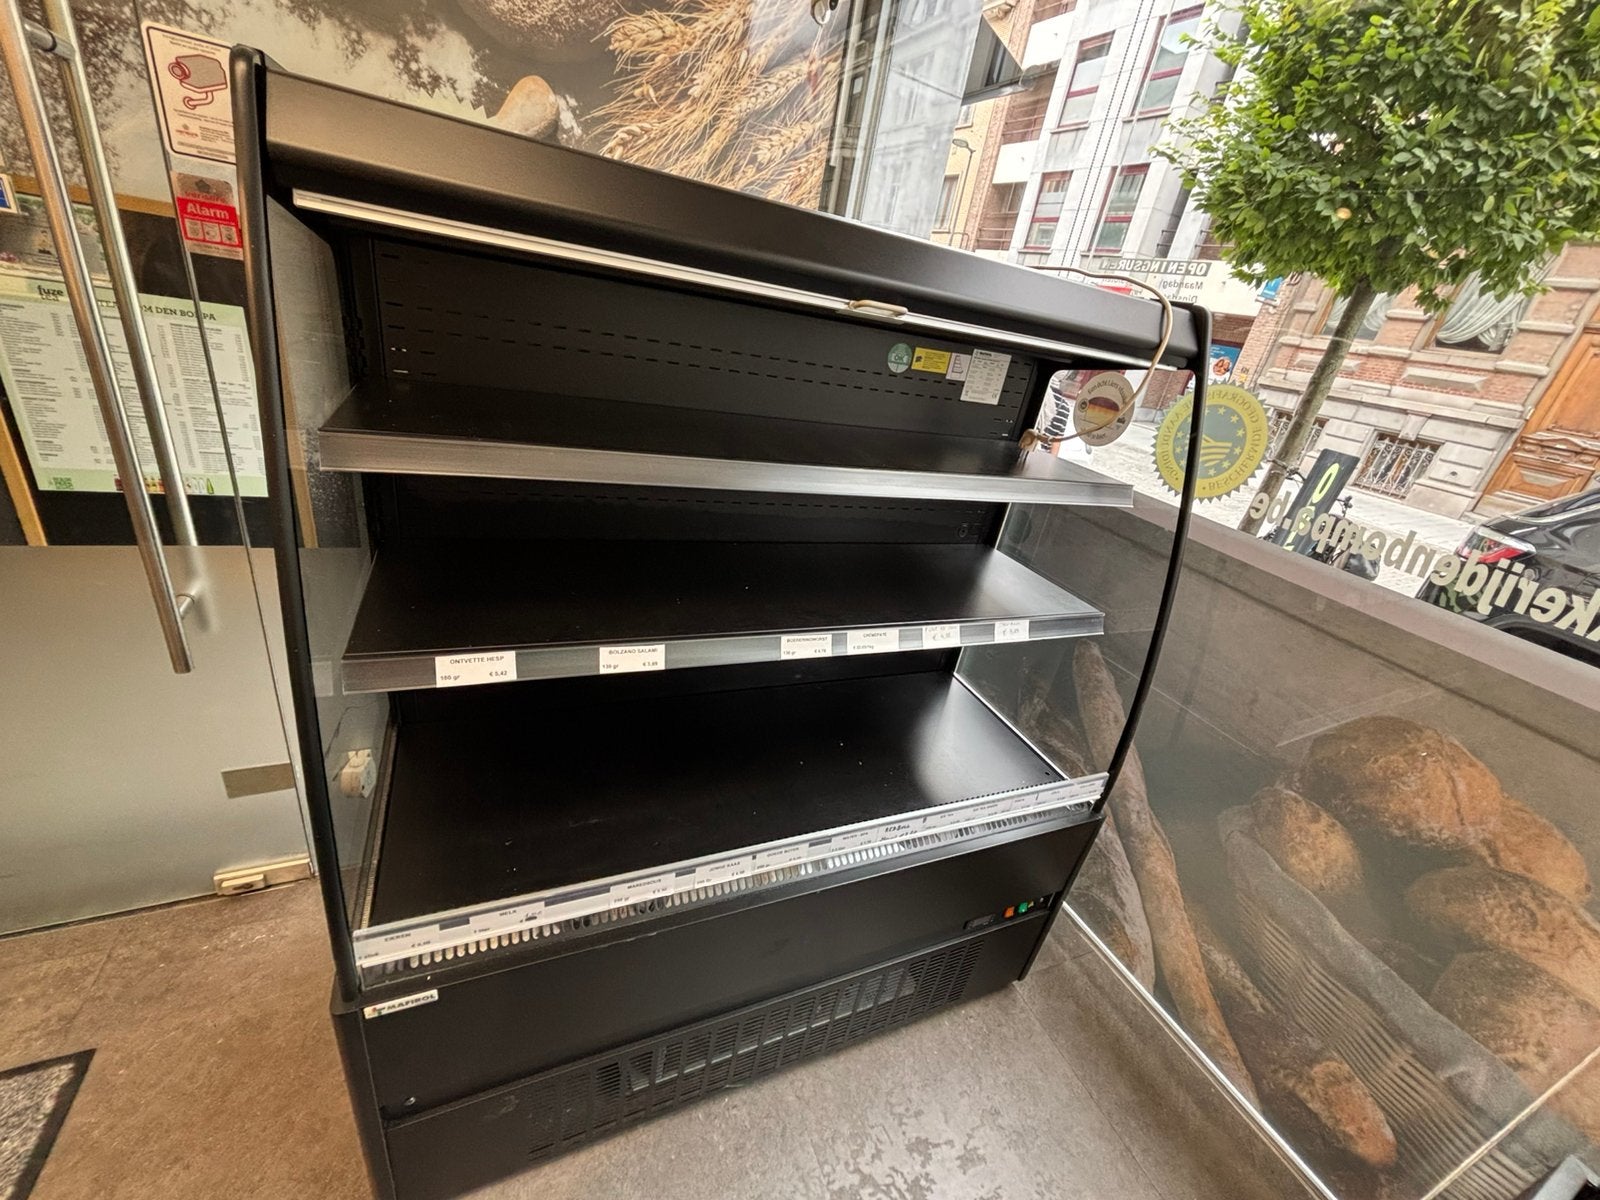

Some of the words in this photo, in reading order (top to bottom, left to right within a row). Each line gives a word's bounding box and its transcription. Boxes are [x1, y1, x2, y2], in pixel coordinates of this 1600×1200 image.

[187, 203, 230, 220] Alarm
[38, 284, 64, 297] fuze
[155, 306, 178, 316] DEN
[609, 648, 637, 656] BOLZANO
[449, 657, 486, 665] ONTVETTE
[486, 655, 504, 663] HESP
[386, 993, 437, 1011] MAFIROL
